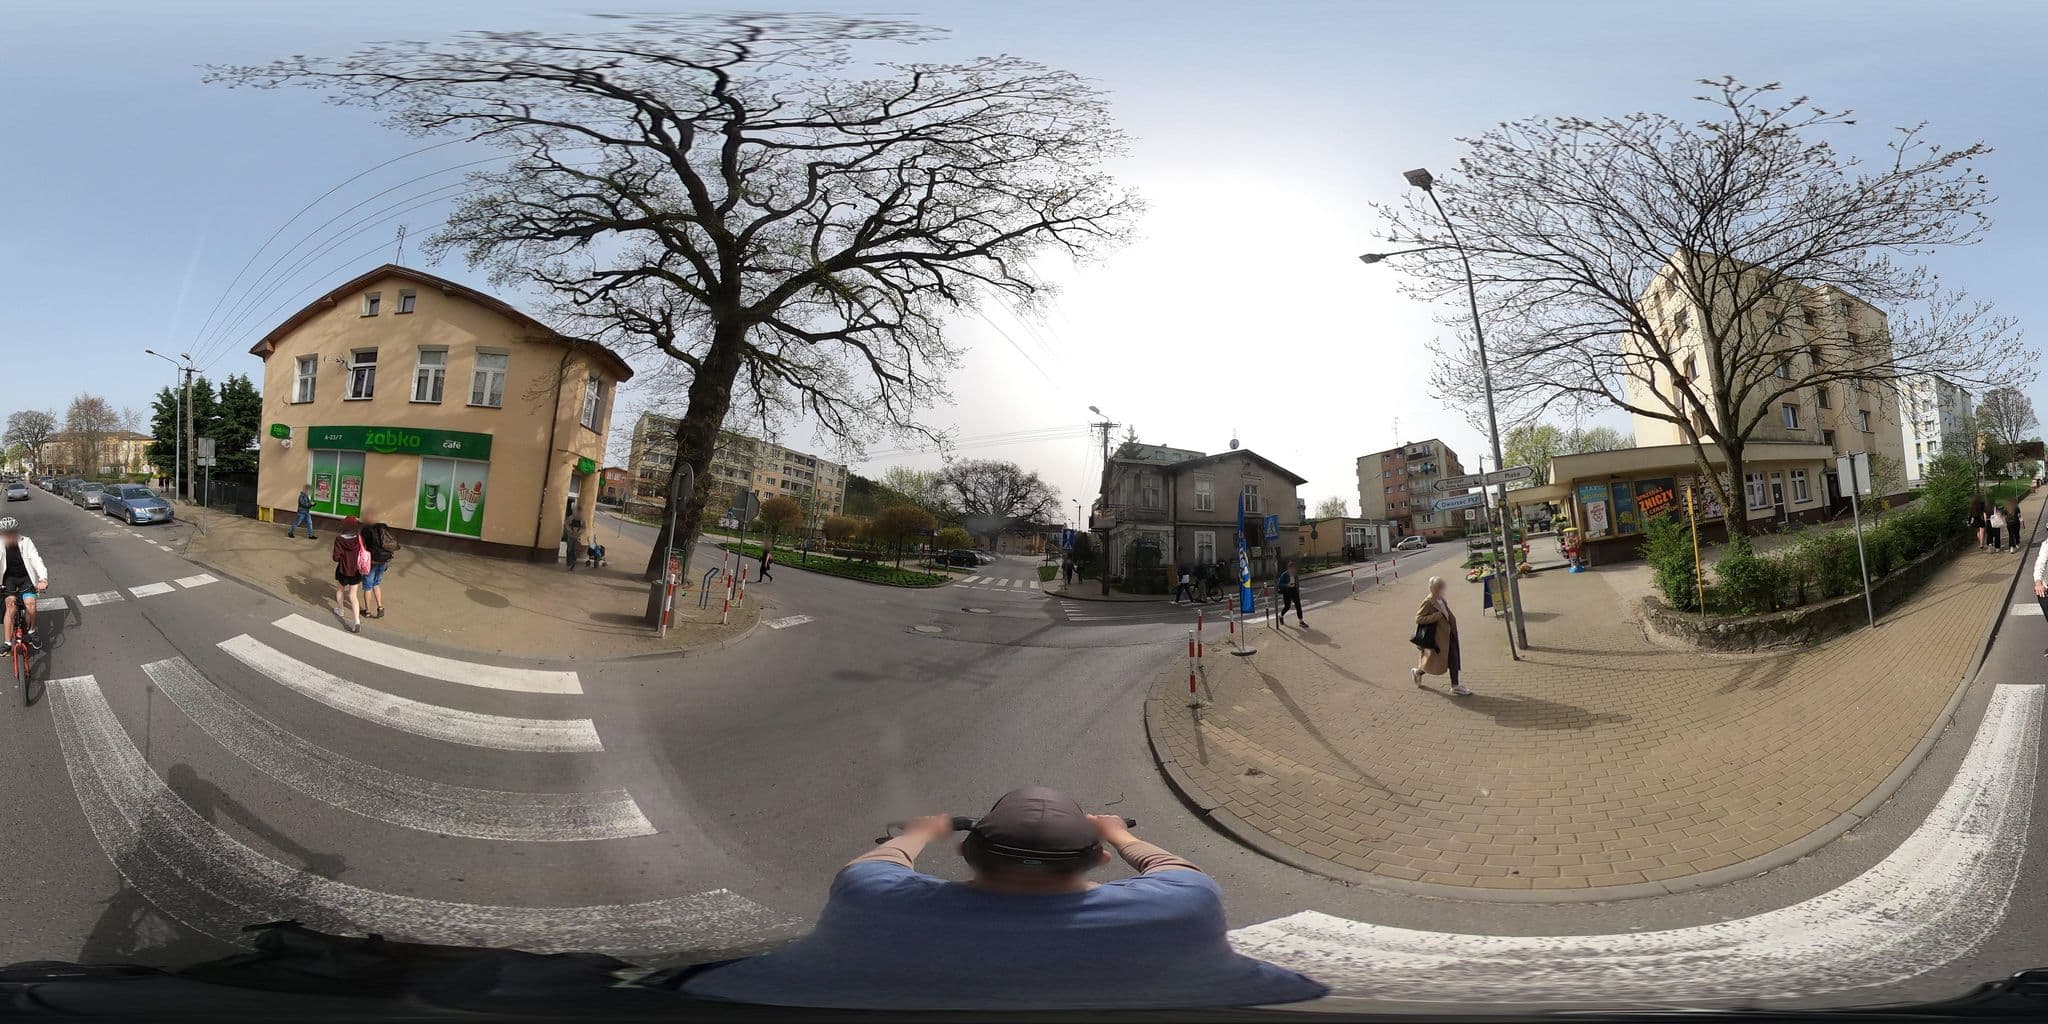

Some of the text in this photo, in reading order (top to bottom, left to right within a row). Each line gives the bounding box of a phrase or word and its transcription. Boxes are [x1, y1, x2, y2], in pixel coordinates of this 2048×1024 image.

[366, 429, 420, 448] żabka
[443, 441, 461, 449] café
[1442, 499, 1466, 507] Dworzec
[1640, 489, 1673, 510] ZNICZY
